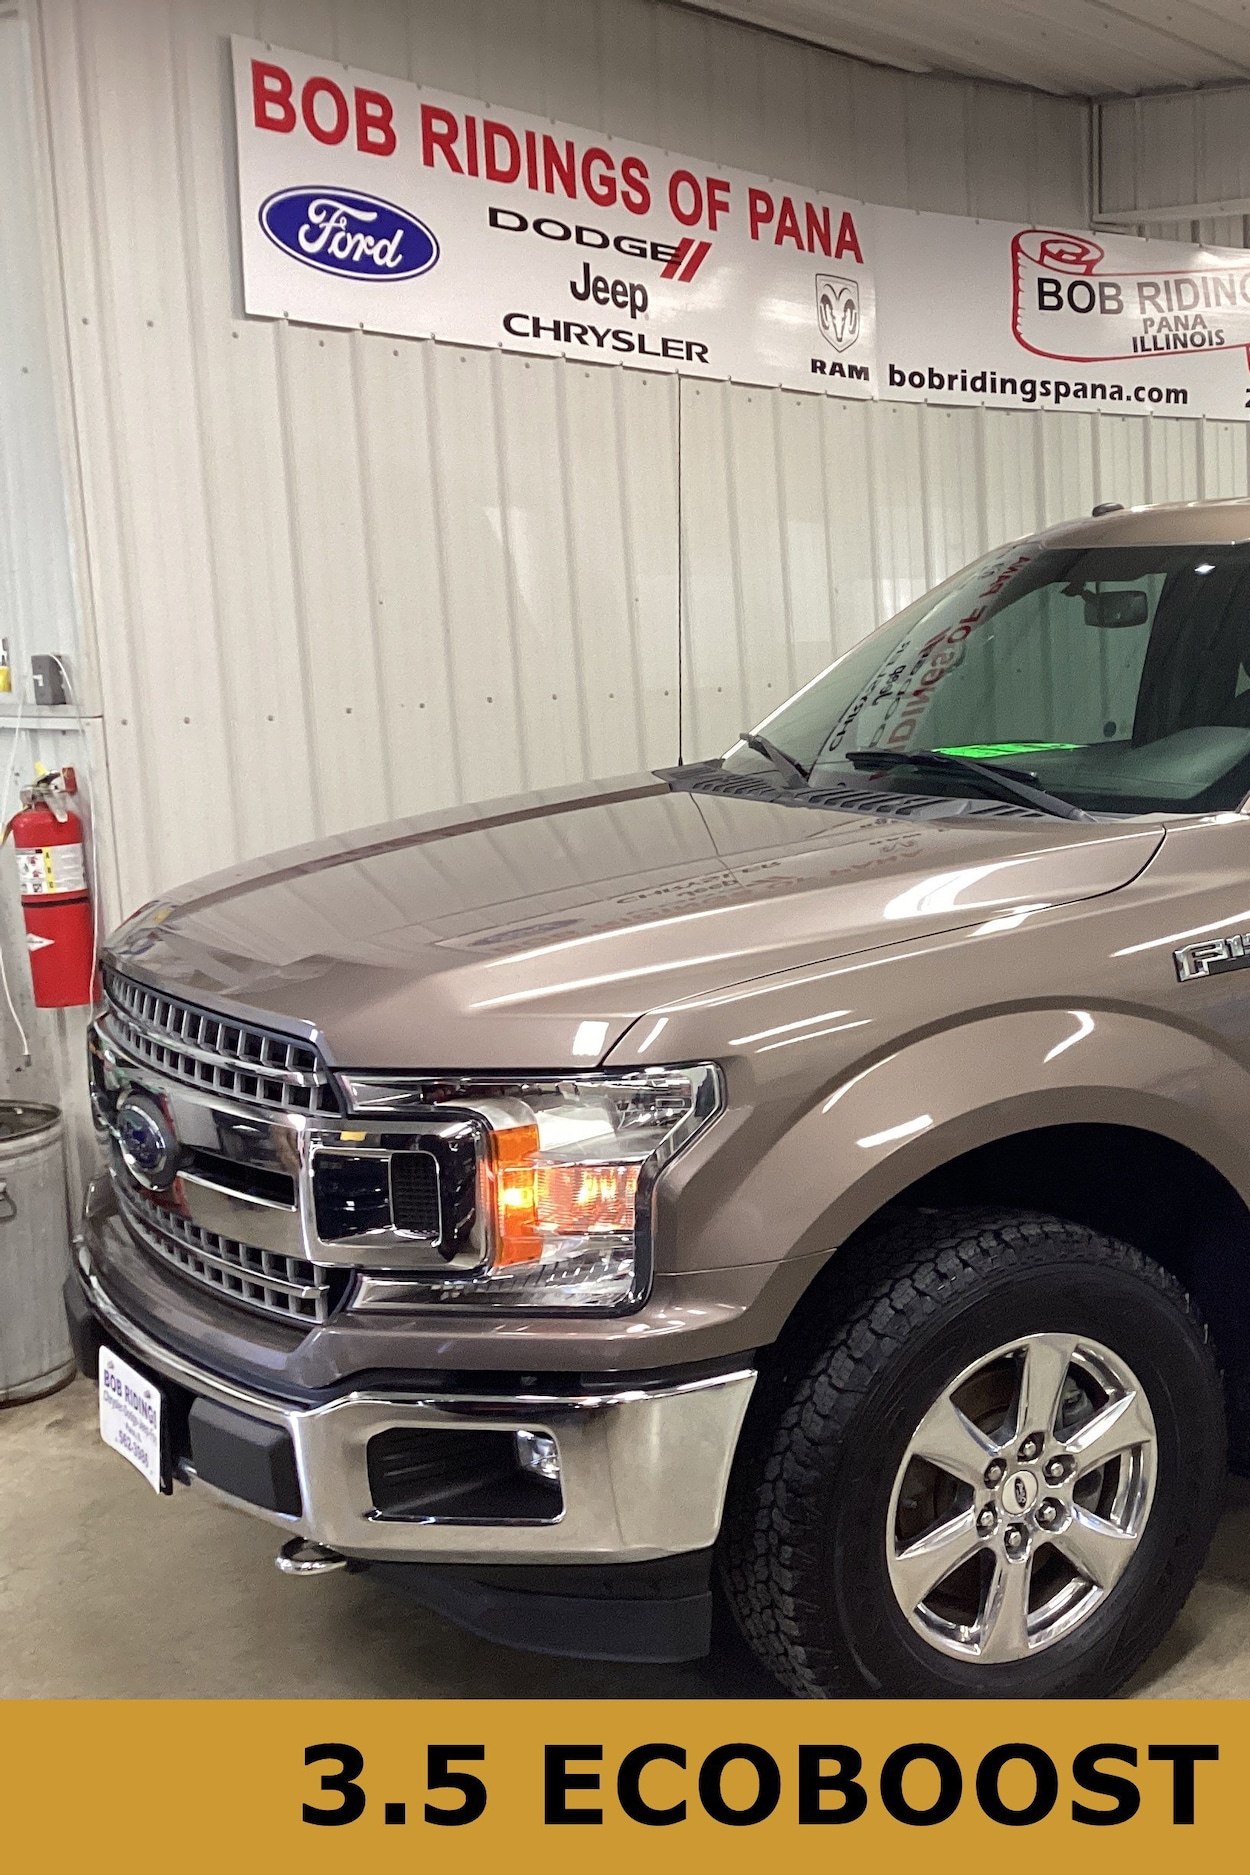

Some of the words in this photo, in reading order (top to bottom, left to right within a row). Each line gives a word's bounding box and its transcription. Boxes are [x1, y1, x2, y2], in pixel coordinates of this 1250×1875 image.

[251, 59, 397, 157] BOB
[420, 103, 652, 216] RIDINGS
[668, 169, 731, 231] OF
[748, 187, 864, 264] PANA
[299, 198, 404, 269] Ford
[488, 206, 682, 266] DODGE
[569, 262, 648, 319] Jeep
[1037, 277, 1124, 315] BOB
[501, 312, 709, 364] CHRYSLER
[1132, 329, 1225, 353] ILLINOIS
[1143, 314, 1207, 334] PANA
[811, 358, 870, 381] RAM
[888, 364, 1188, 405] bobridingspana.com
[104, 1369, 122, 1397] BOB
